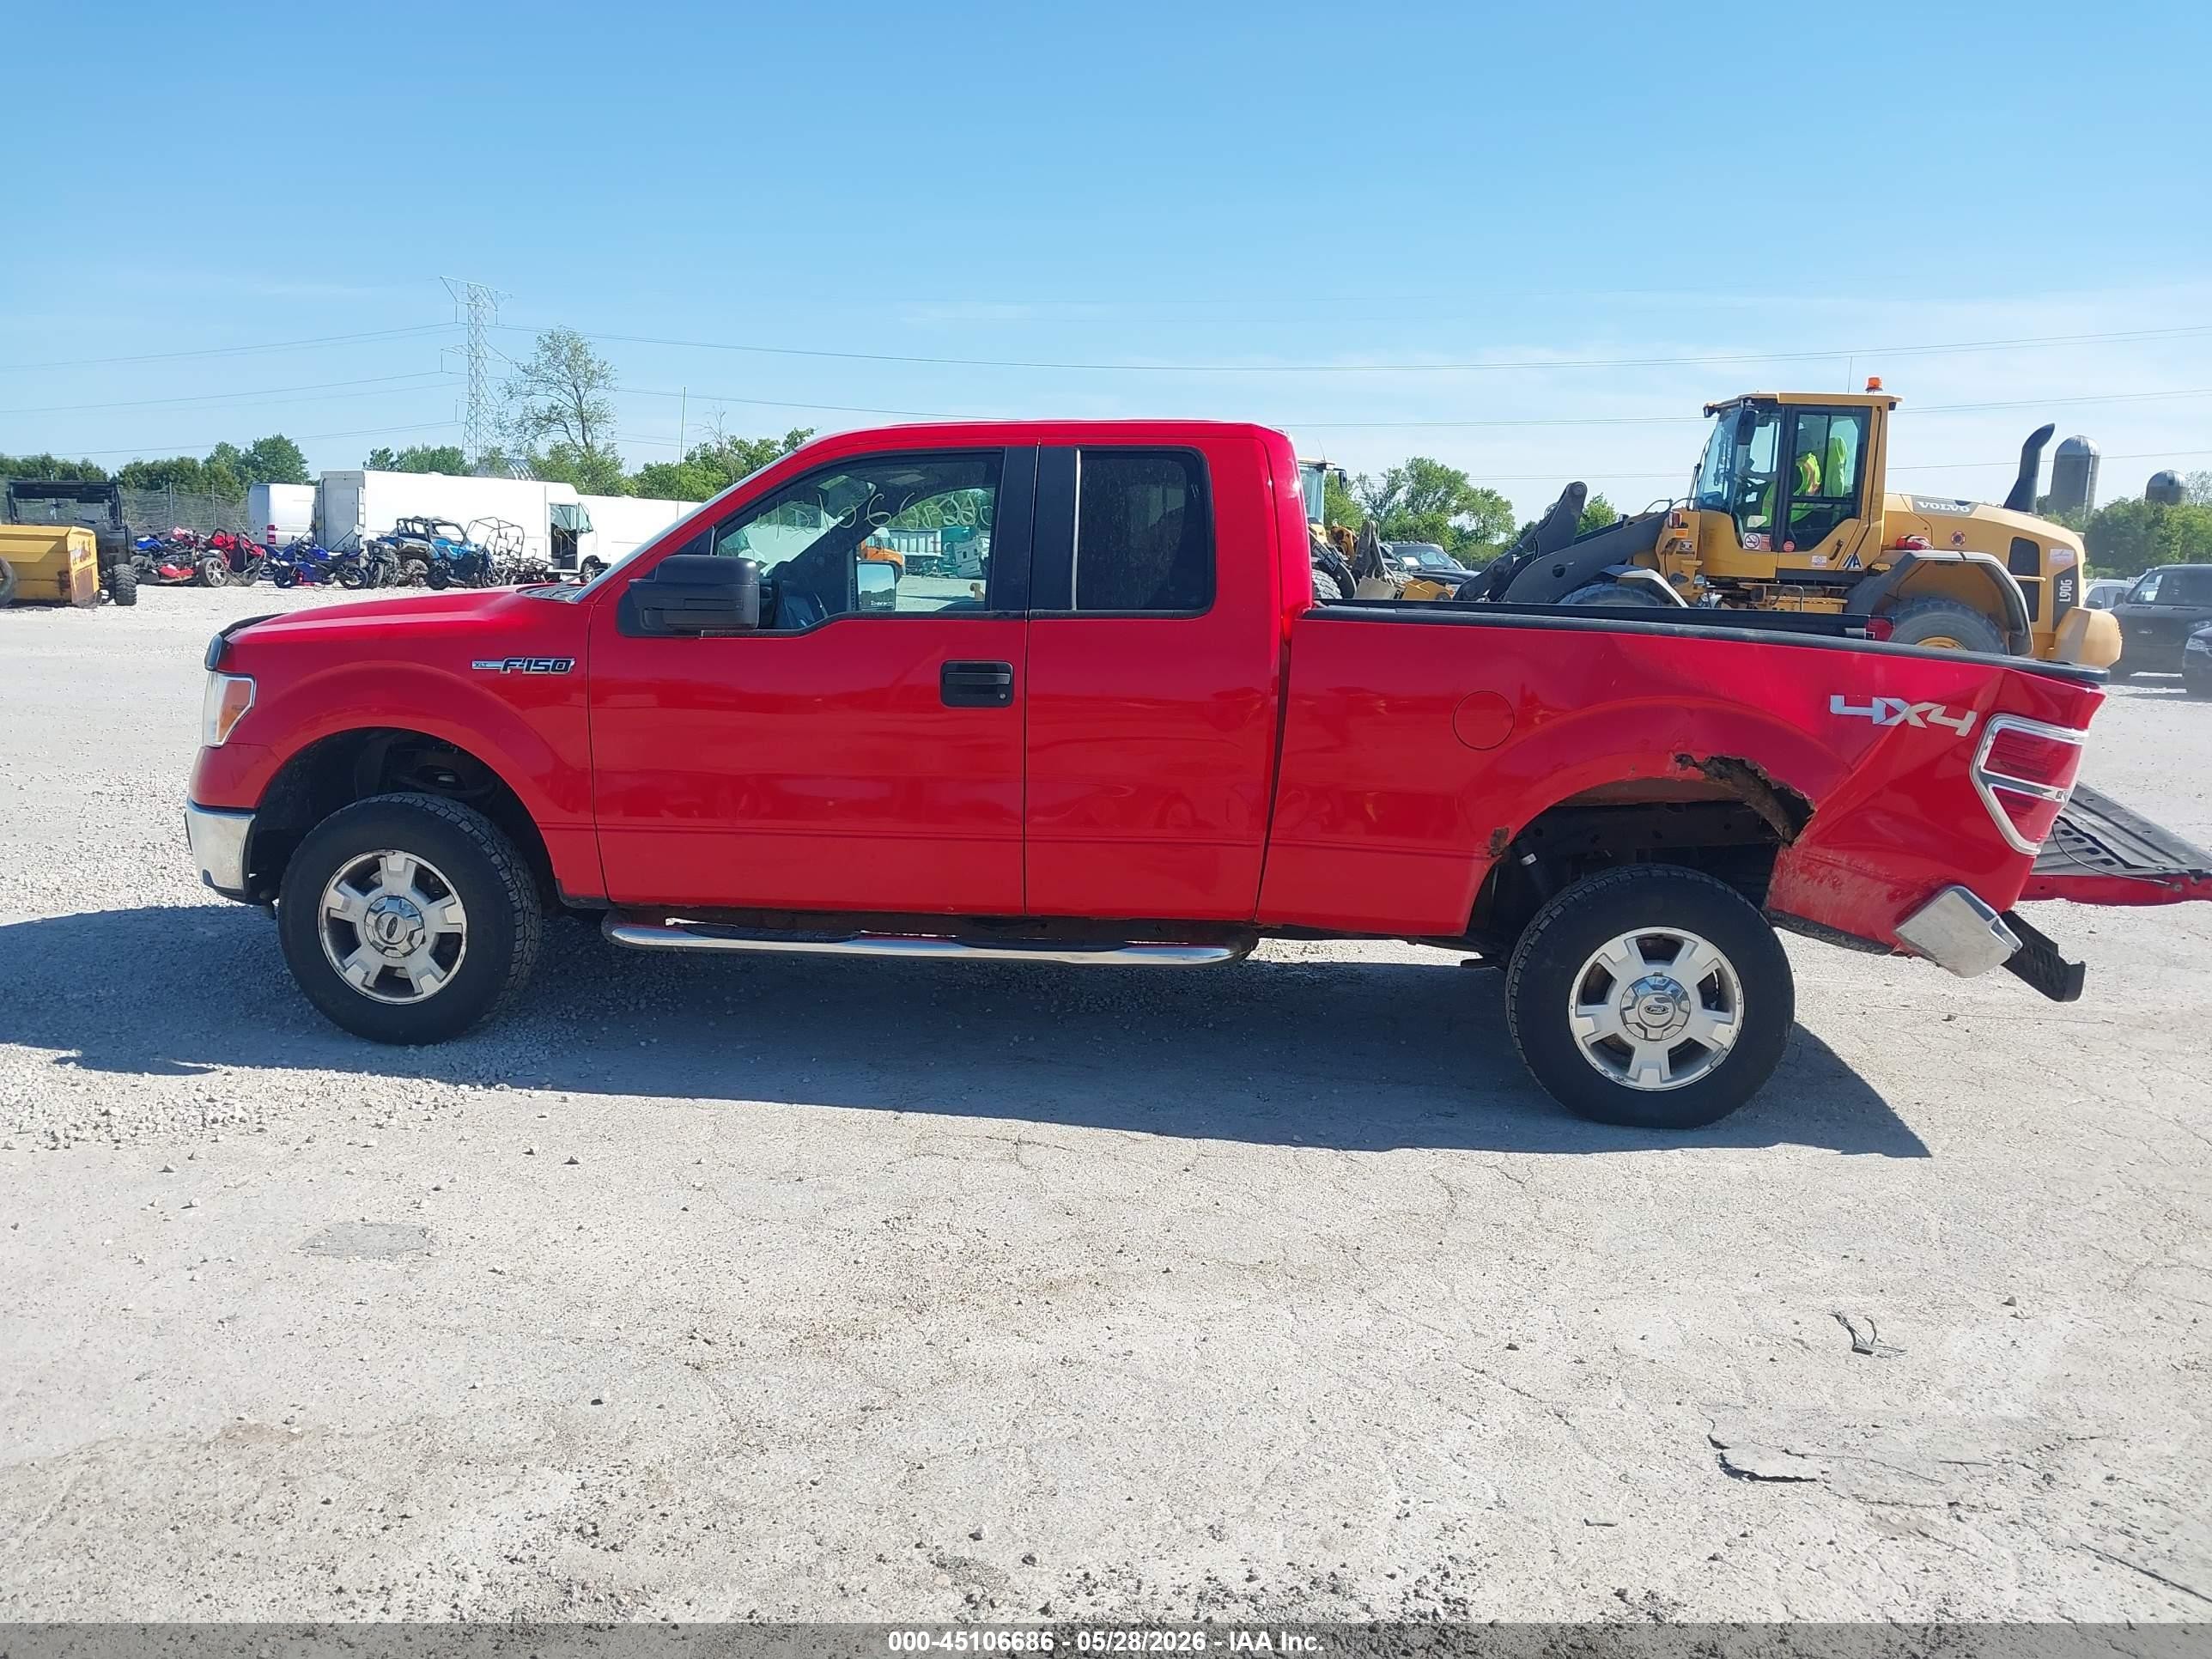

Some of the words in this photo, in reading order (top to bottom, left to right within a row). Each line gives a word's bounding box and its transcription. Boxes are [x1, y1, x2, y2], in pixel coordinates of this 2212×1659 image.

[1917, 501, 1971, 513] VOLVO
[2058, 579, 2073, 603] L90G
[500, 657, 574, 674] F-150
